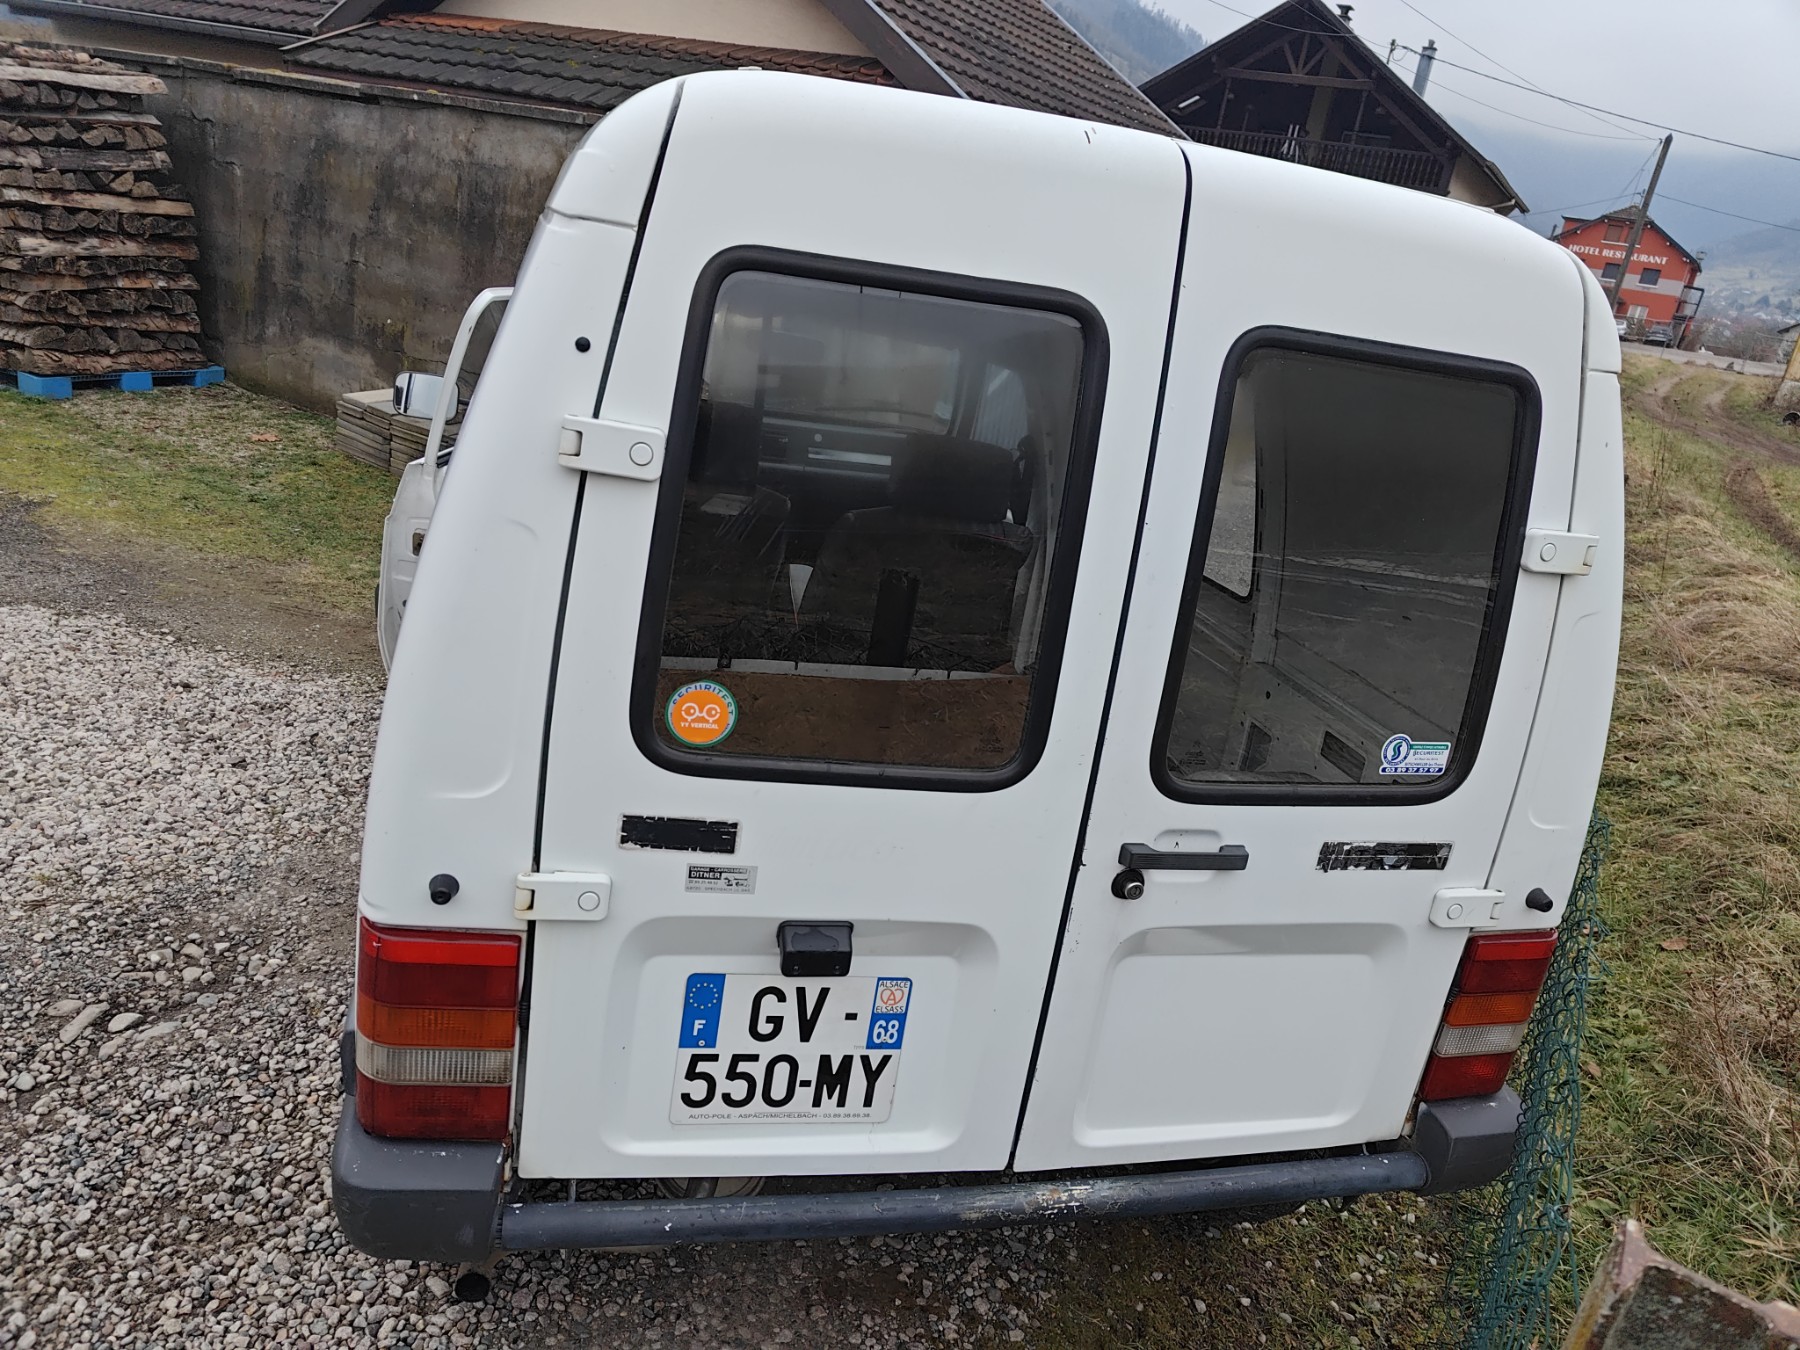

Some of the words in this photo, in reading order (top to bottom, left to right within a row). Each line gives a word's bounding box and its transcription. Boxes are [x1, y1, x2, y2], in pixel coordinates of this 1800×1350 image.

[1568, 244, 1600, 256] HOTEL
[691, 871, 720, 879] DITNER
[879, 981, 909, 989] ALSACE
[748, 985, 831, 1043] GV
[875, 1005, 904, 1013] ELSASS
[692, 1019, 706, 1036] F
[872, 1019, 900, 1044] 68
[680, 1053, 892, 1109] 550-MY
